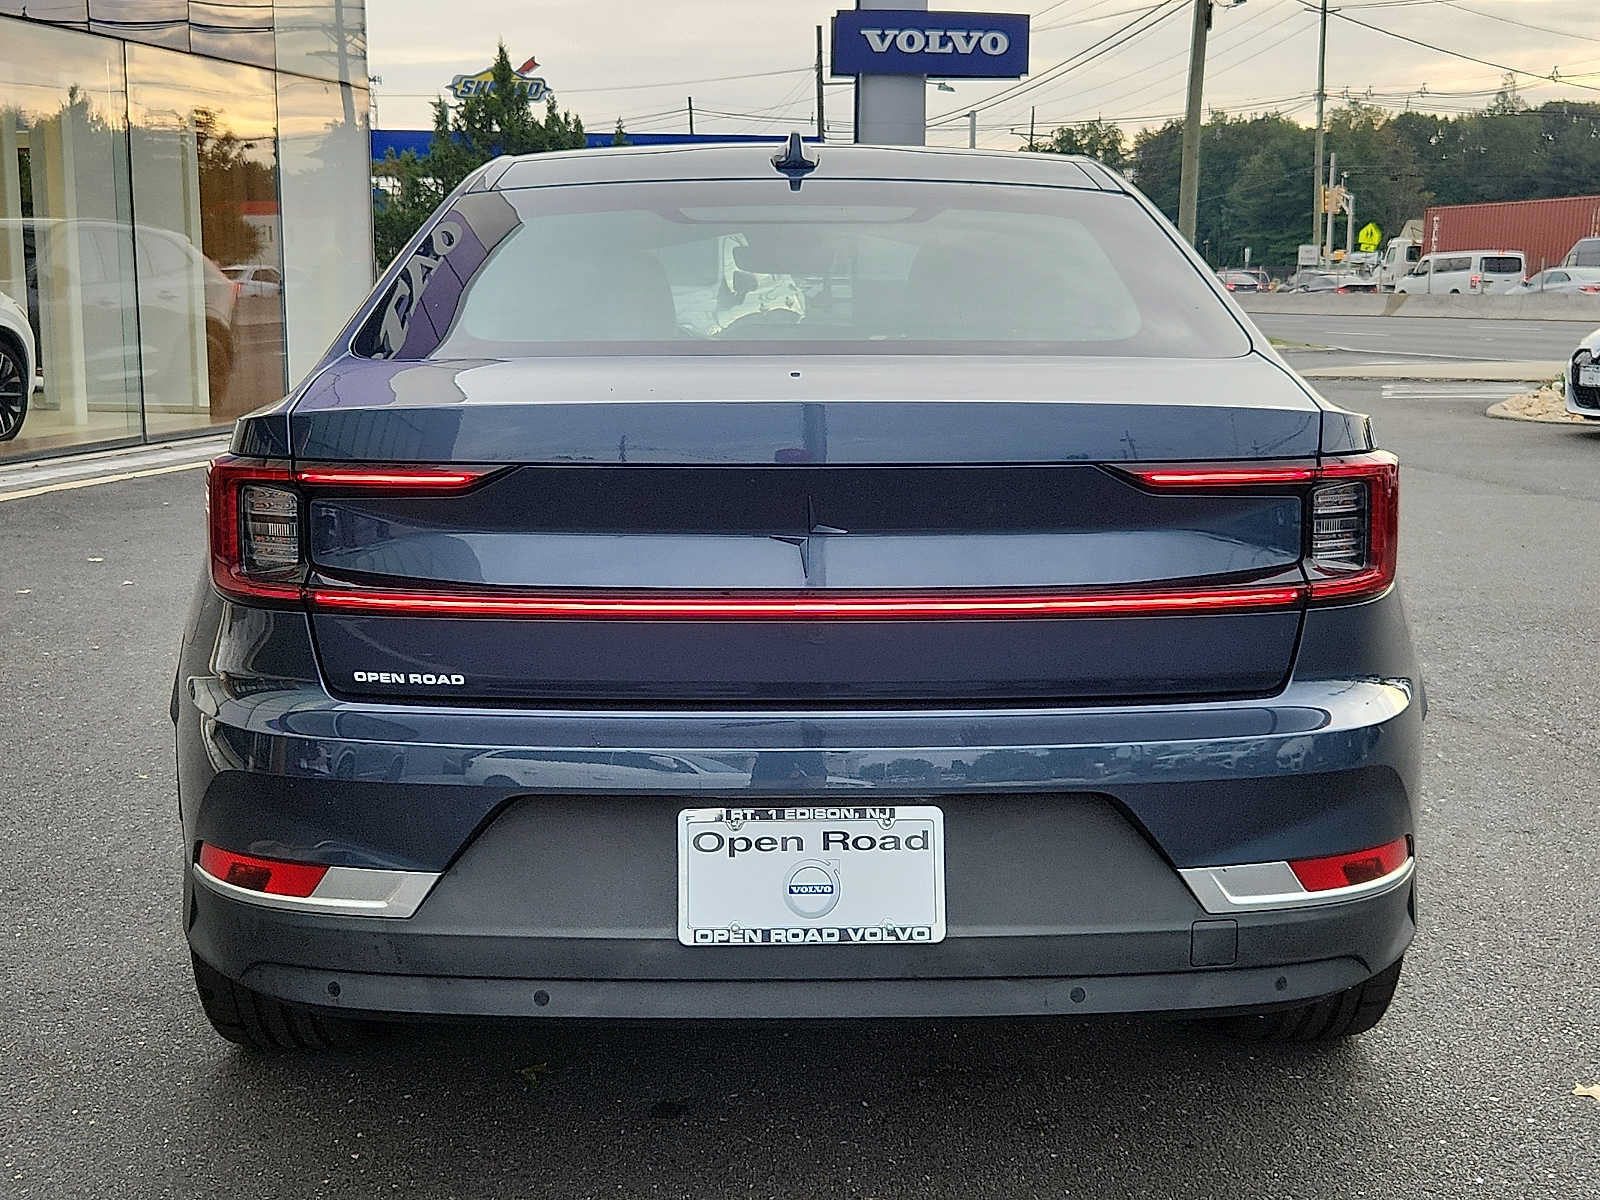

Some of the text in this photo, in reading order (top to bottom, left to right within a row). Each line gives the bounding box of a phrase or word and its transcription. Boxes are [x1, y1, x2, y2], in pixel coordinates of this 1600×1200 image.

[860, 30, 1009, 55] VOLVO
[353, 671, 465, 685] OPEN ROAD
[767, 809, 777, 820] 1
[866, 808, 890, 820] NJ
[692, 829, 929, 858] Open Road
[790, 886, 833, 894] VOLVO
[695, 926, 932, 943] OPEN ROAD VOLVO
